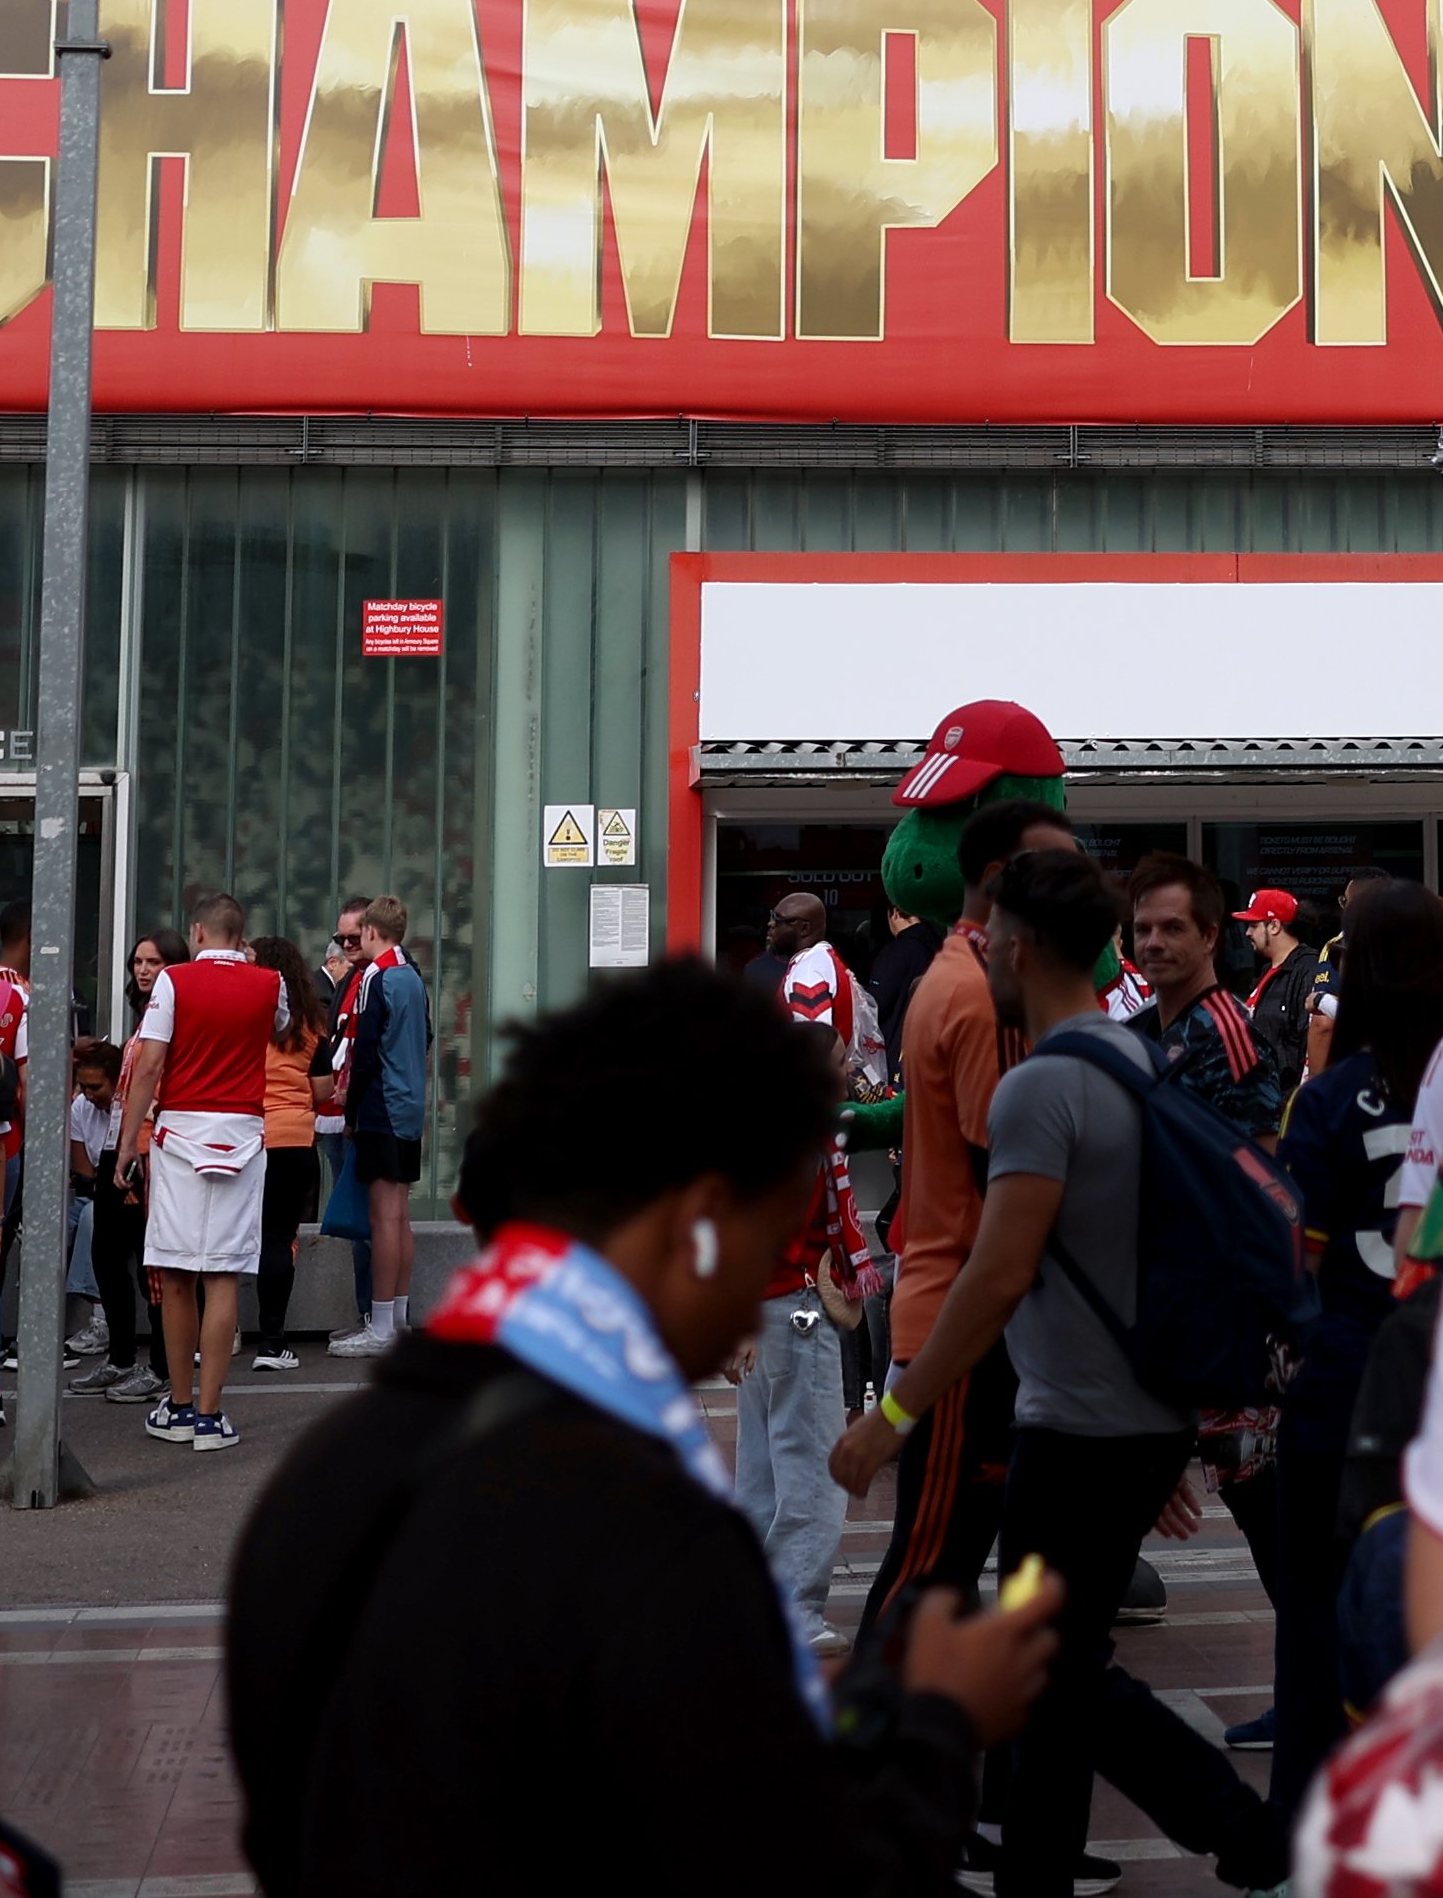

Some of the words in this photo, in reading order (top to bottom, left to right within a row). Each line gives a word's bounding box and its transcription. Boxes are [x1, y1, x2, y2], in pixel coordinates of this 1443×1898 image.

[367, 602, 408, 612] Matchday
[409, 602, 438, 612] bicycle
[368, 614, 399, 623] parking
[400, 613, 437, 622] available
[365, 625, 374, 634] at
[375, 624, 412, 635] Highbury
[413, 624, 440, 634] House
[602, 839, 630, 847] Danger
